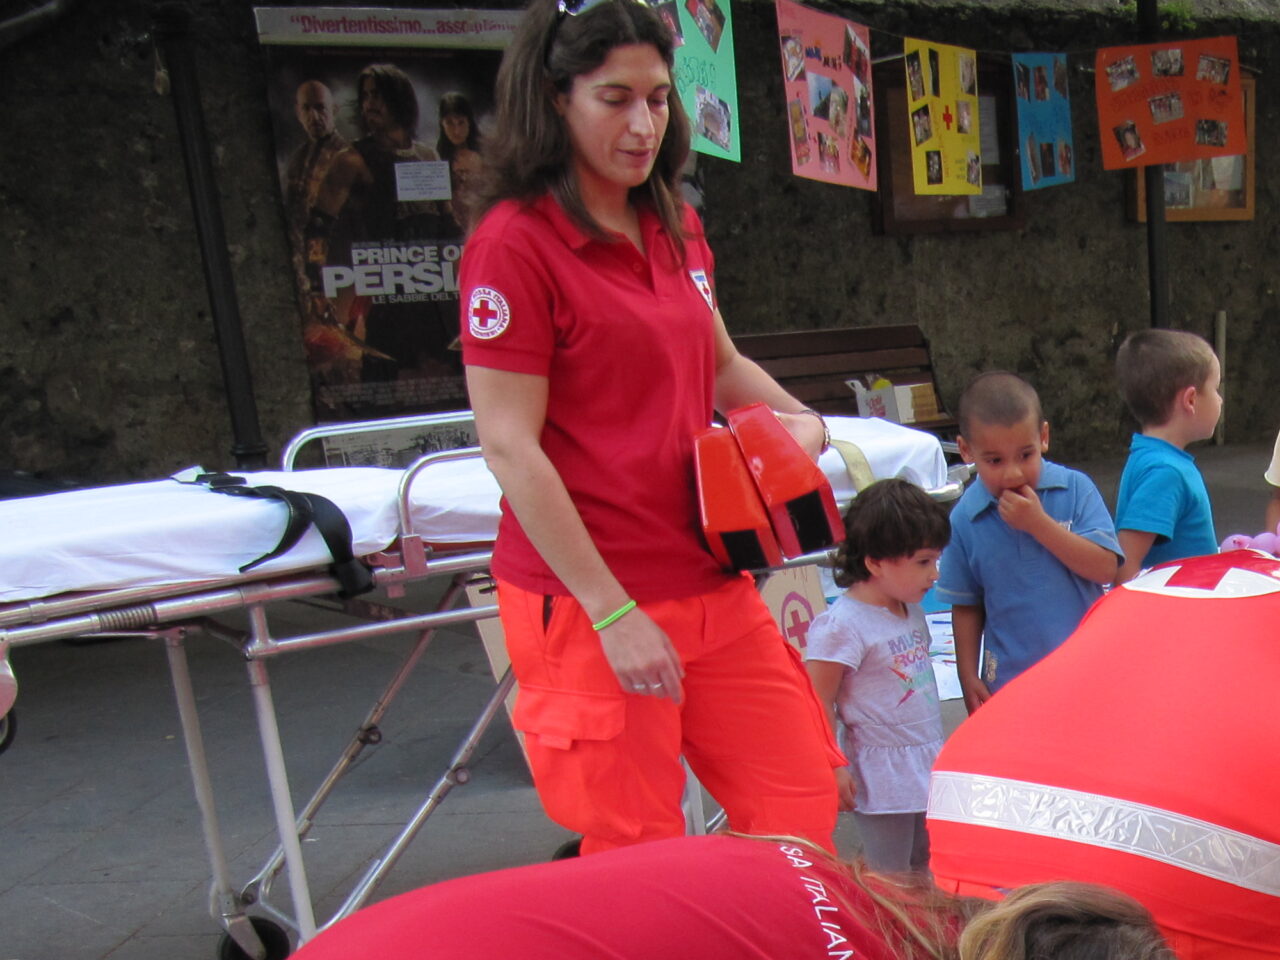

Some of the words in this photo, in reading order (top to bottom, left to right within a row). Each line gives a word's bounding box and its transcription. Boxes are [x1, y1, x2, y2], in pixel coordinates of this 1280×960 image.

[352, 246, 438, 265] PRINCE
[322, 261, 460, 299] PERSI
[372, 295, 386, 304] LE
